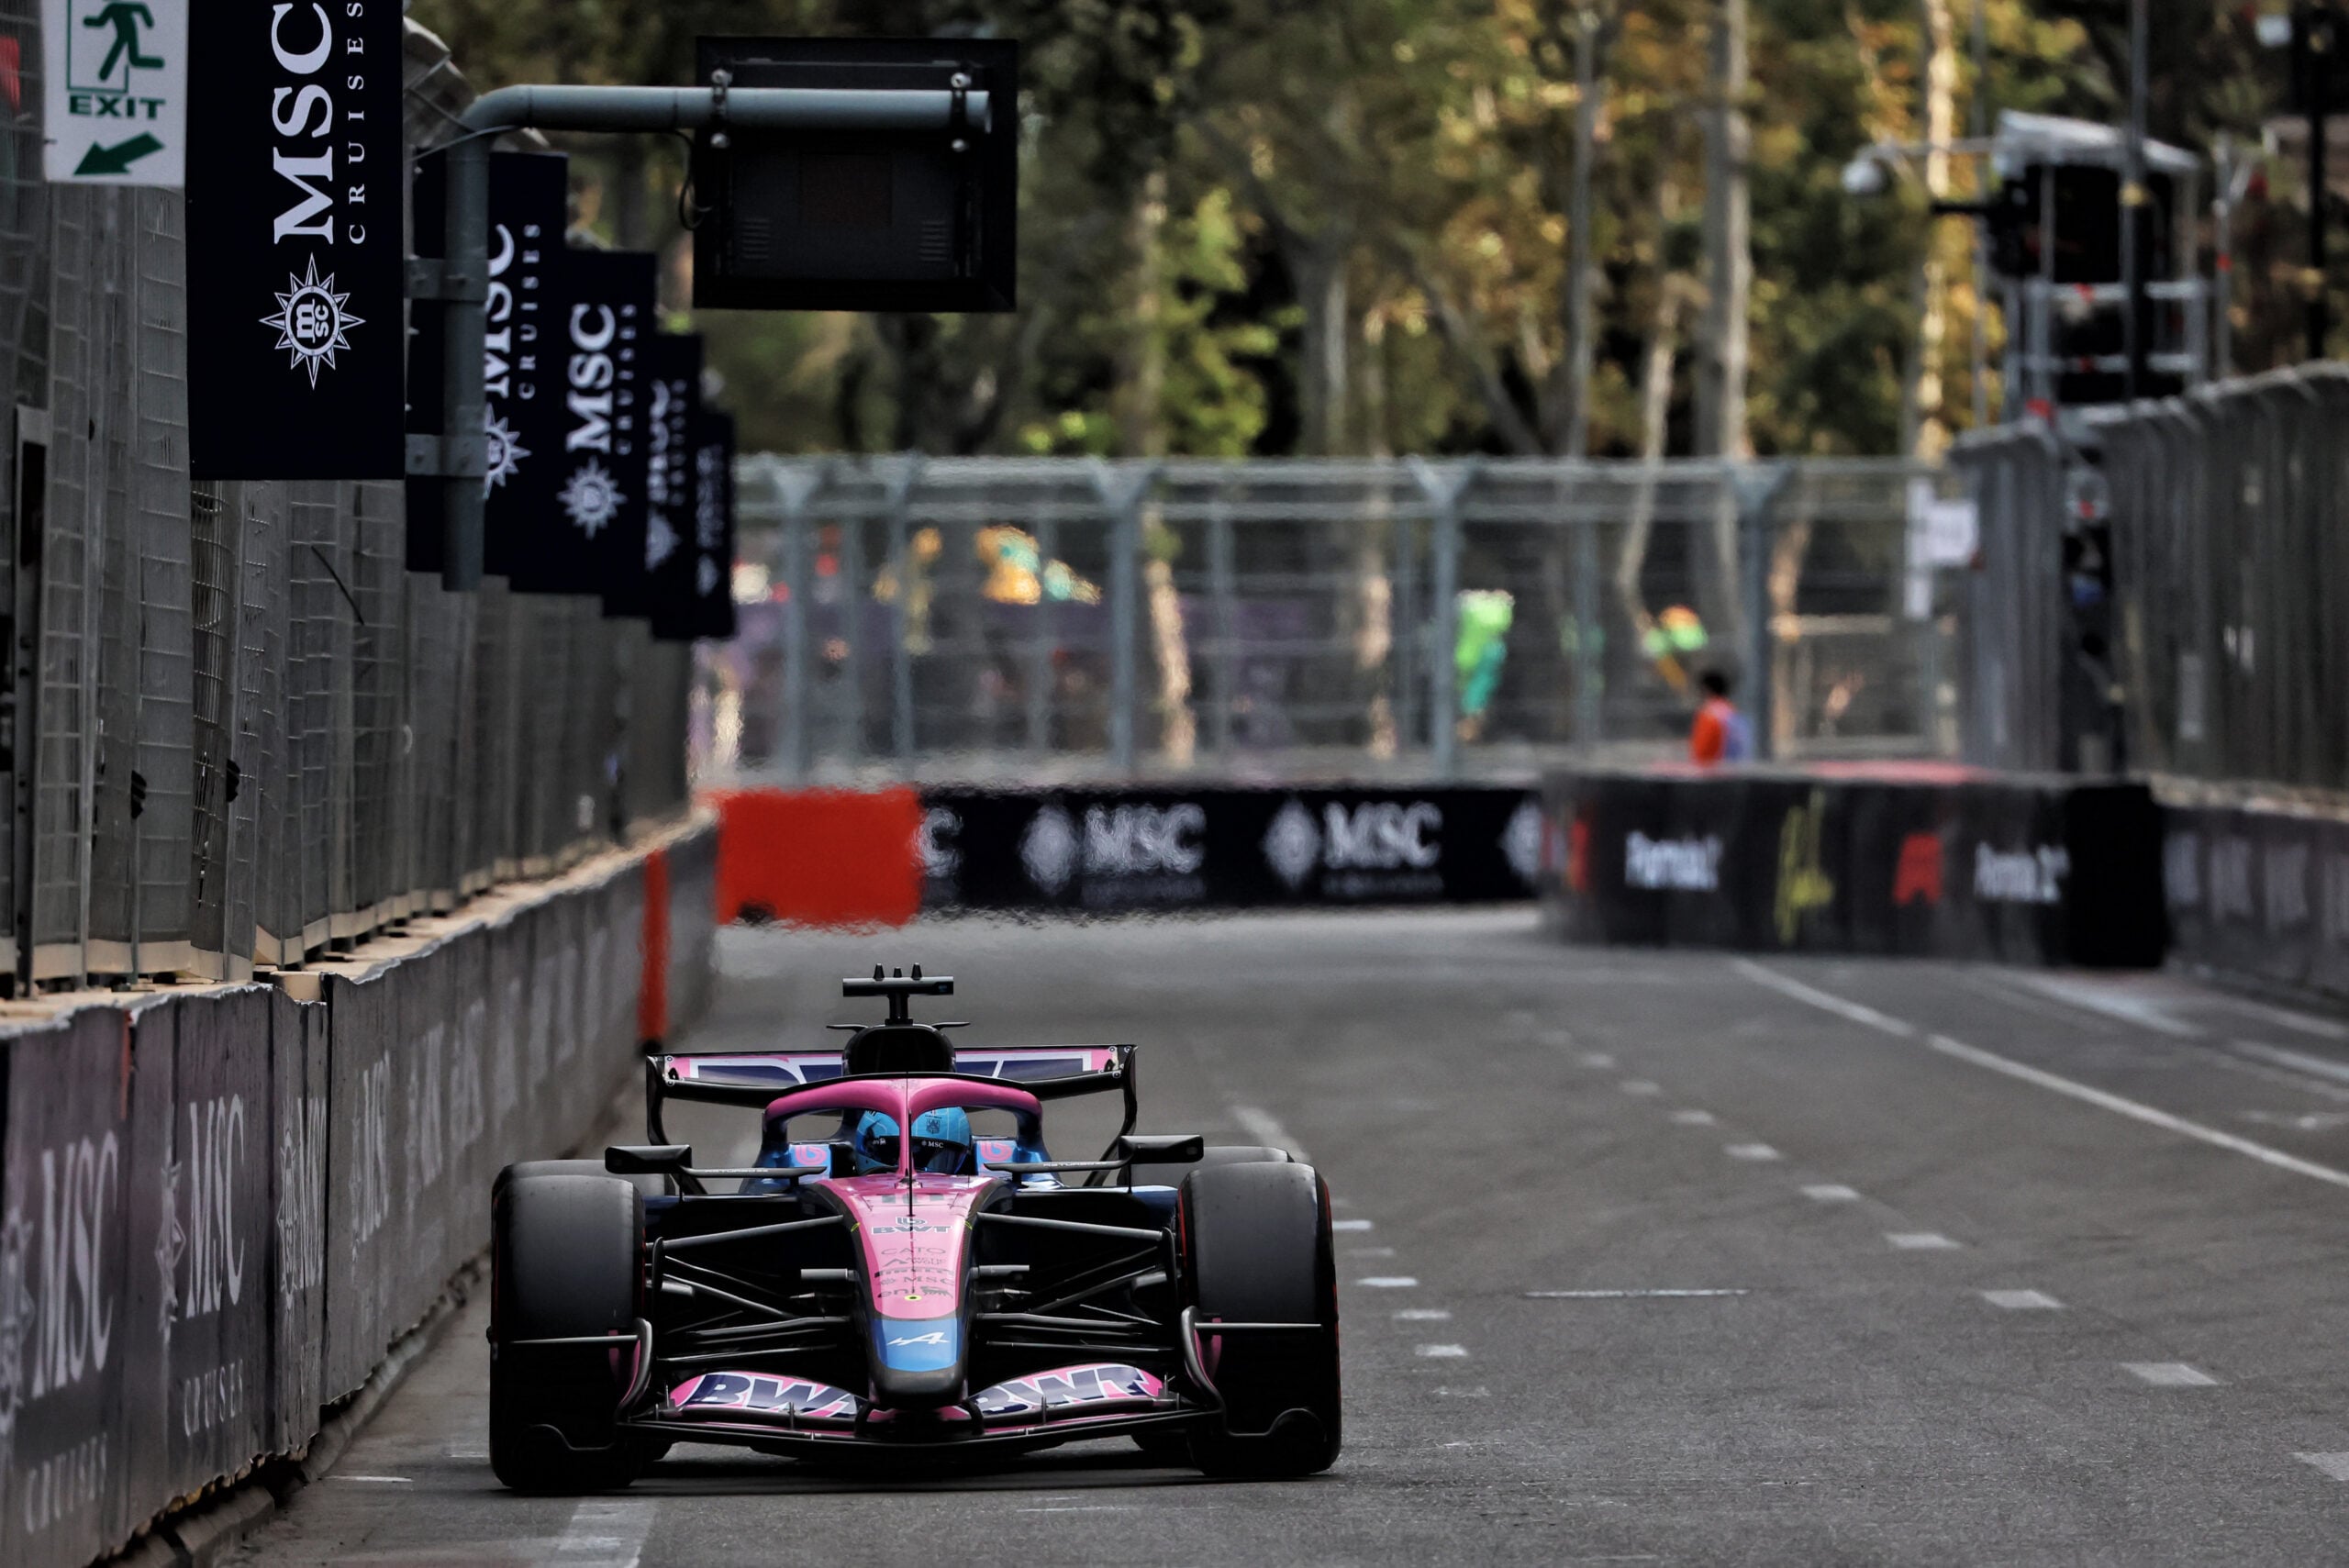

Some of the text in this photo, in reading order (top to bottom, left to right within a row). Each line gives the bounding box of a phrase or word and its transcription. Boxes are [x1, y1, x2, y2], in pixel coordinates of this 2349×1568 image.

[69, 95, 165, 120] EXIT
[271, 3, 333, 245] MSC
[347, 3, 366, 245] CRUISES
[518, 223, 540, 399] CRUISES
[566, 303, 616, 455] MSC
[1083, 802, 1208, 874] MSC
[1323, 802, 1444, 868] MSC
[31, 1129, 118, 1400] MSC
[186, 1093, 244, 1319] MSC
[872, 1226, 952, 1234] BWT
